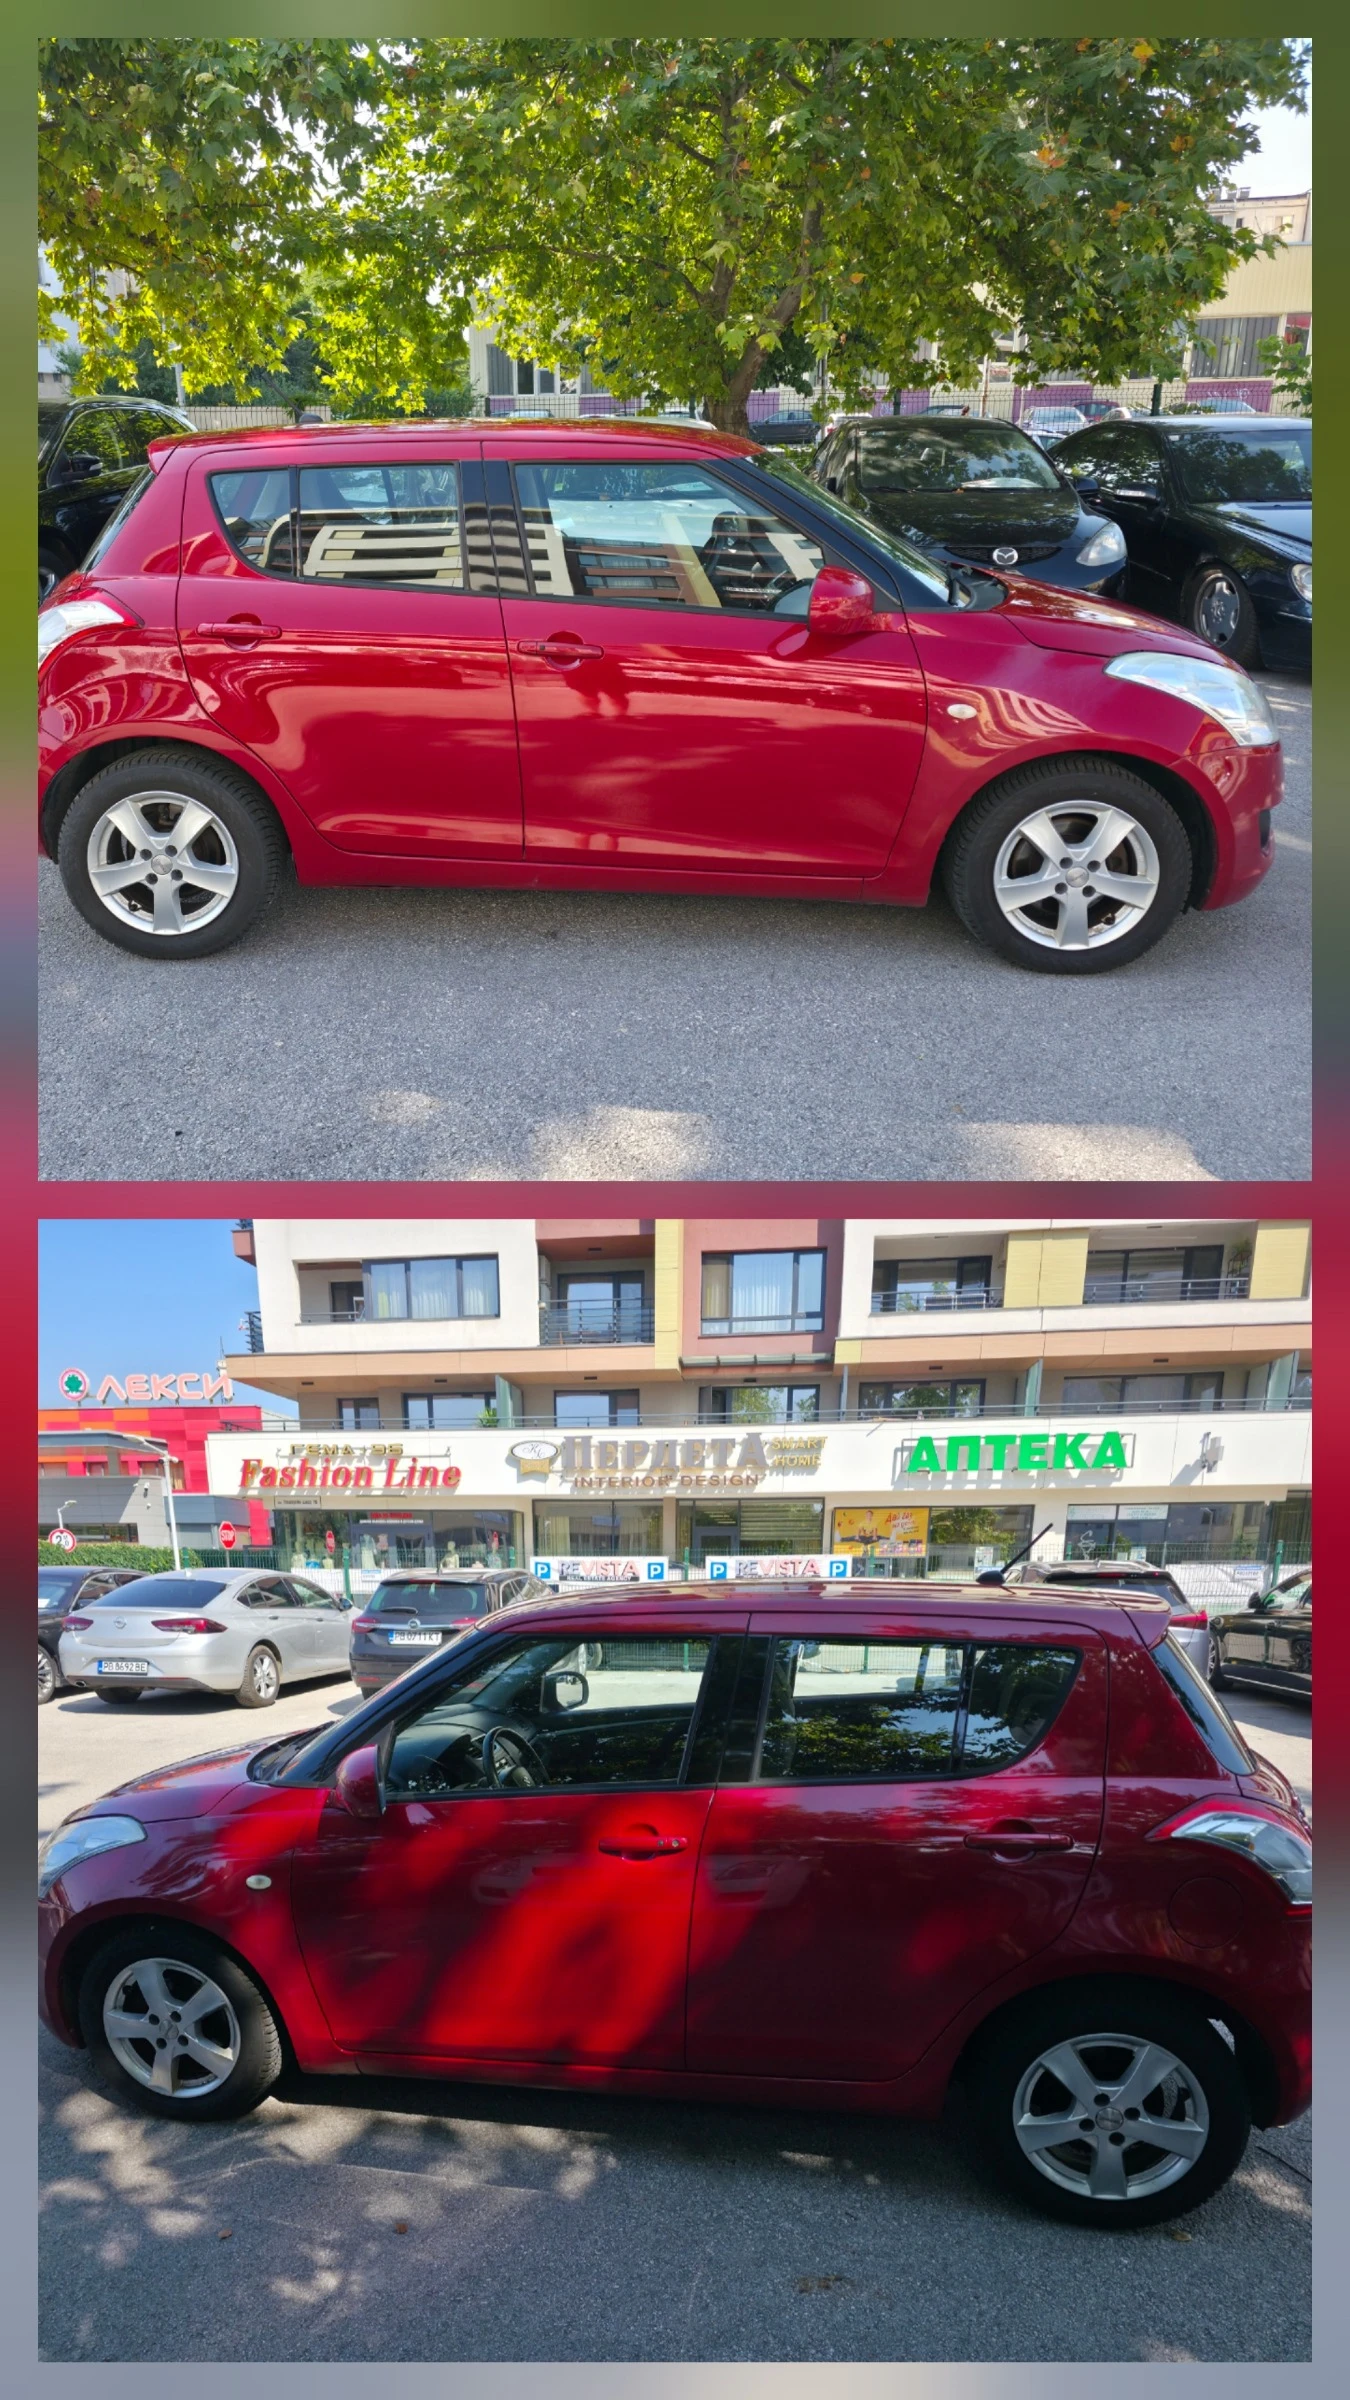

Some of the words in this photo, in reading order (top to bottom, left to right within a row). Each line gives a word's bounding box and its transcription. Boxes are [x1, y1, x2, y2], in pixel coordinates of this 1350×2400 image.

[96, 1373, 233, 1400] ЛЕКСИ
[771, 1436, 828, 1450] SMART
[561, 1432, 769, 1472] ПЕРДЕТА
[907, 1431, 1127, 1472] АПТЕКА
[775, 1454, 822, 1467] HOME
[239, 1458, 374, 1488] Fashion
[384, 1457, 462, 1488] Line
[574, 1476, 671, 1488] INTERIOR
[681, 1475, 759, 1487] DESIGN
[221, 1529, 235, 1541] STOP
[558, 1560, 640, 1576] REVISTA
[735, 1559, 820, 1575] REVISTA
